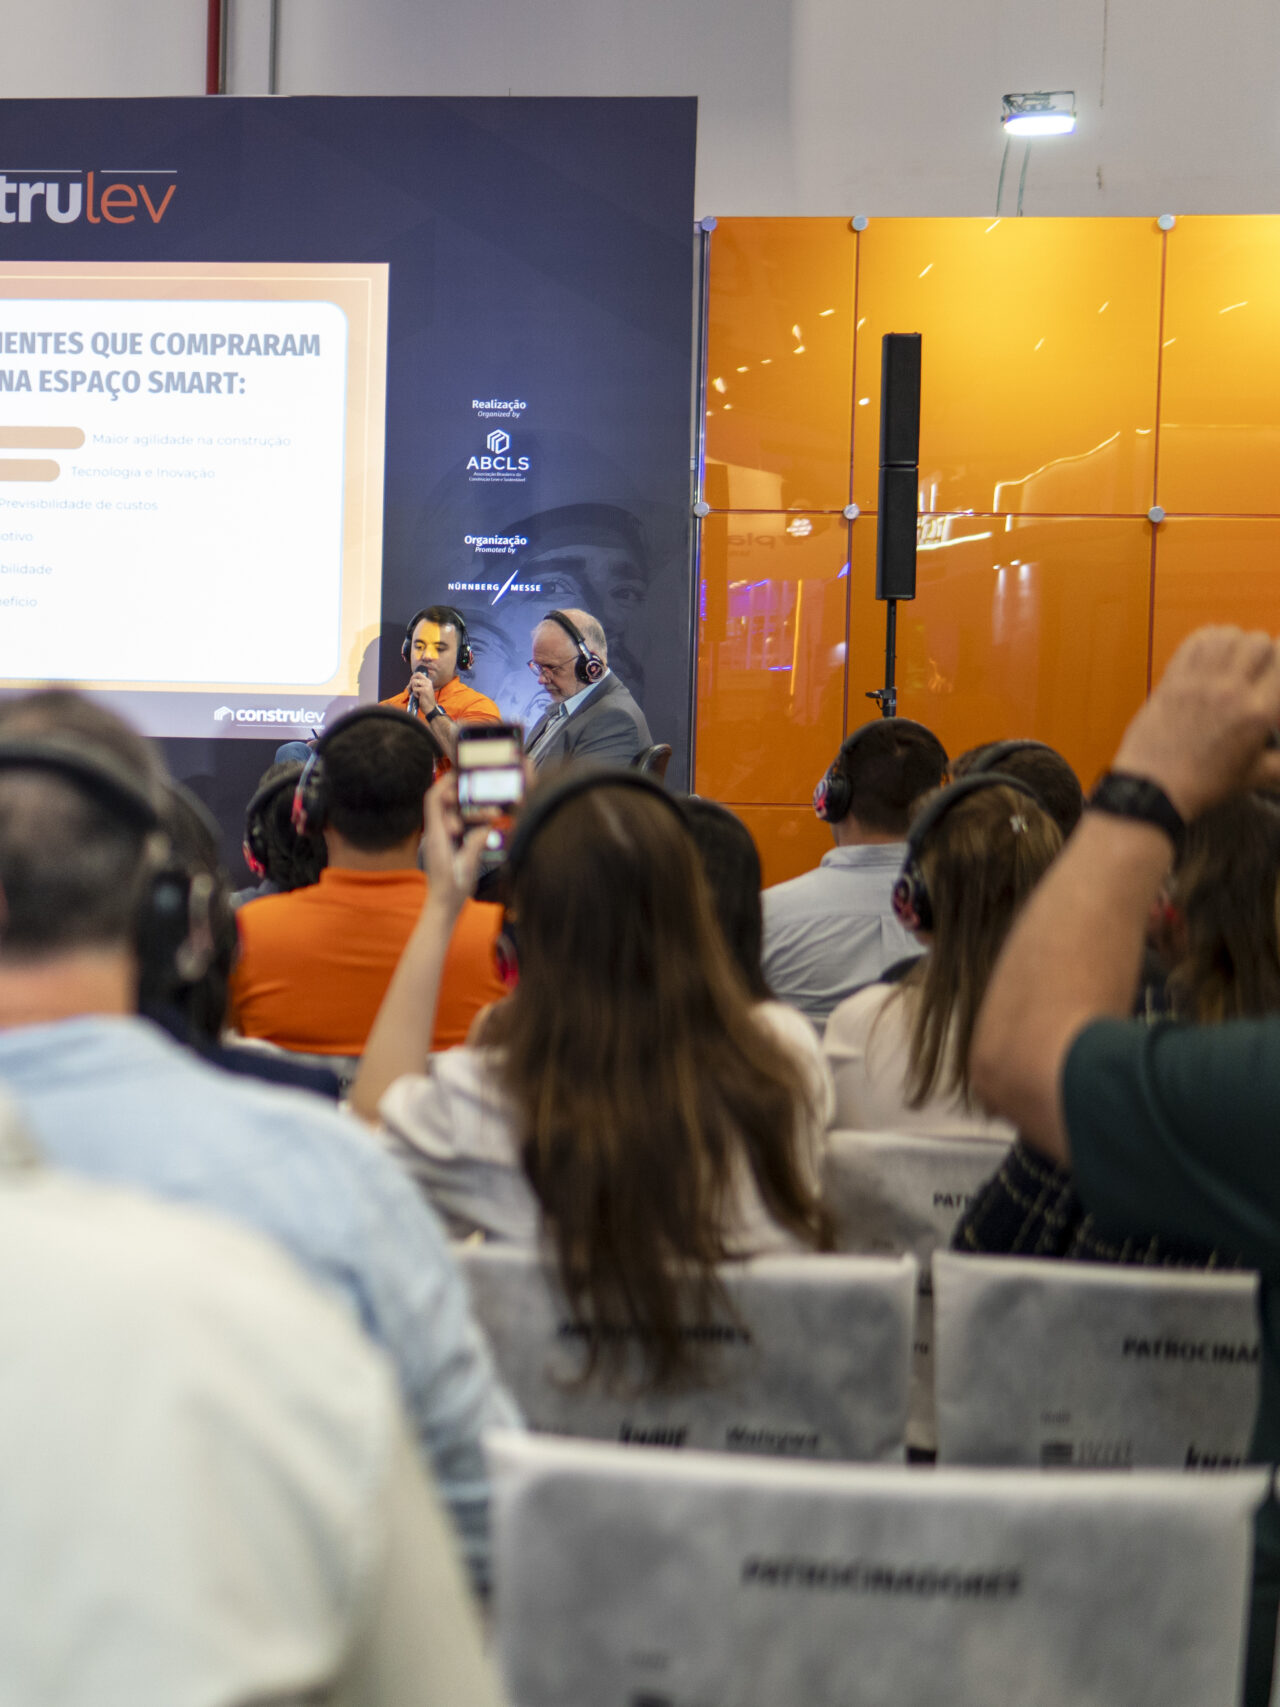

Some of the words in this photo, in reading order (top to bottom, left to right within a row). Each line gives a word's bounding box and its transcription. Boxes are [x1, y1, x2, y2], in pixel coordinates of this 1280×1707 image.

[91, 332, 143, 359] QUE
[150, 333, 321, 357] COMPRARAM
[39, 370, 141, 401] ESPAÇO
[148, 371, 246, 394] SMART:
[472, 399, 527, 412] Realização
[92, 433, 129, 445] Maior
[133, 433, 194, 449] agilidade
[198, 436, 213, 446] na
[466, 456, 530, 471] ABCLS
[71, 466, 141, 481] Tecnologia
[96, 499, 113, 511] de
[116, 500, 158, 511] custos
[464, 534, 527, 547] Organização
[448, 581, 499, 592] NÜRNBERG
[511, 583, 541, 592] MESSE
[236, 707, 326, 723] construlev
